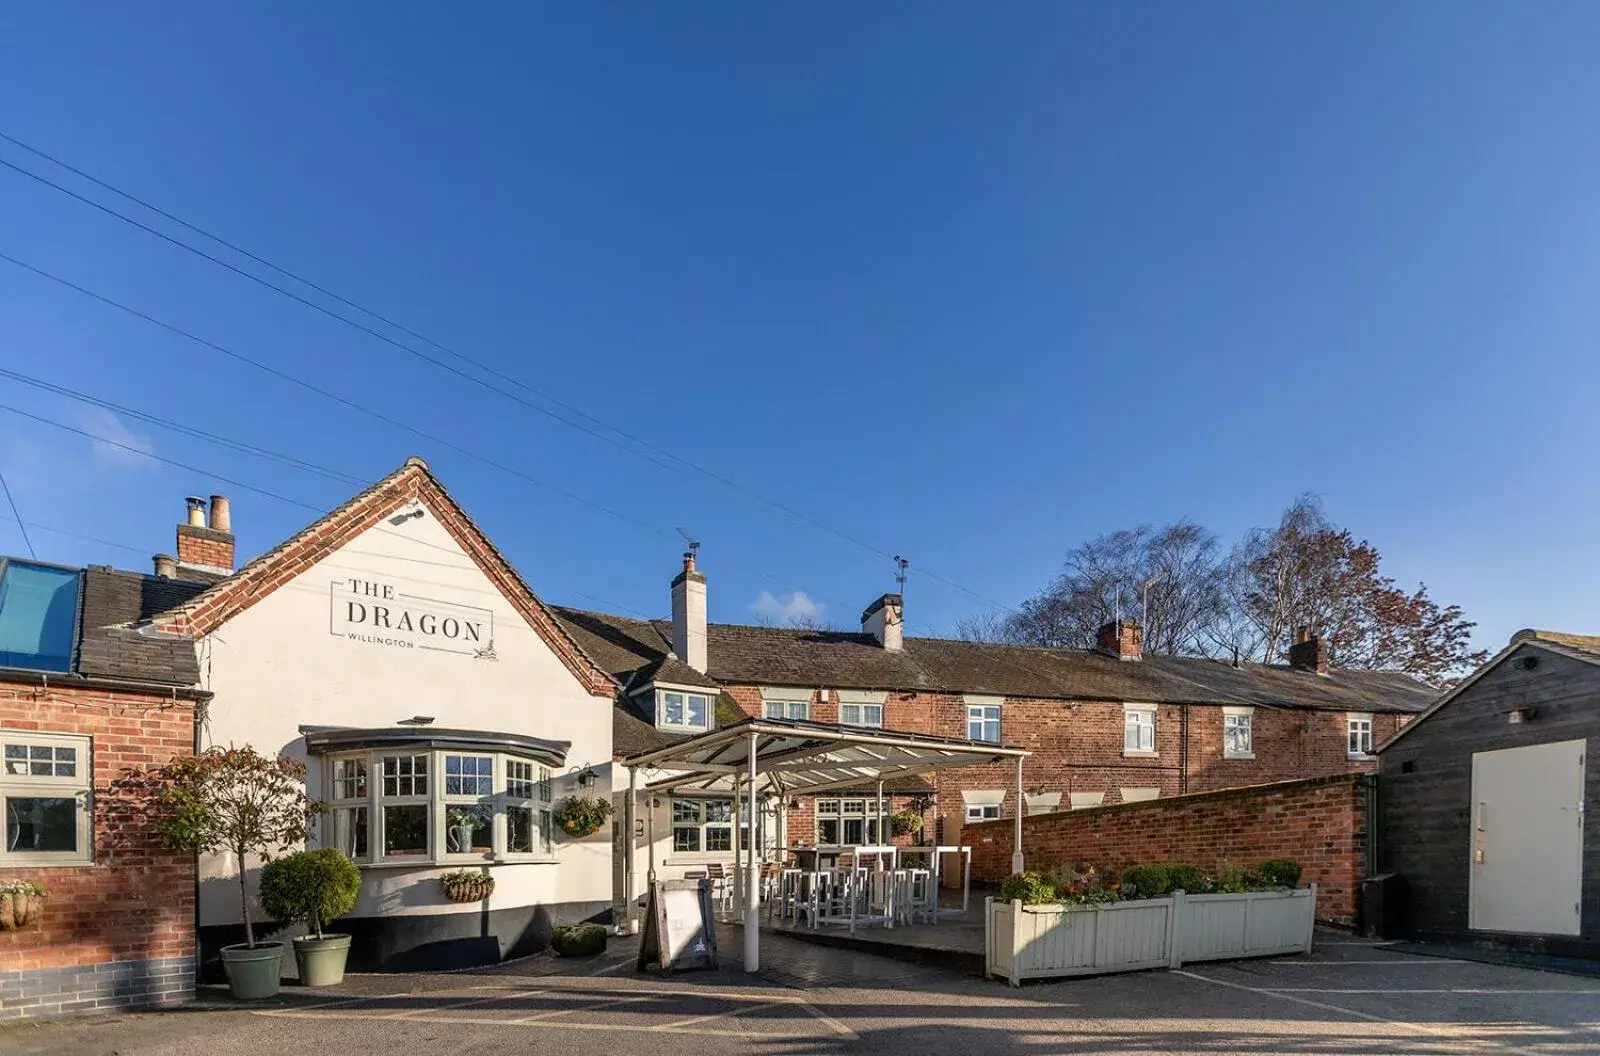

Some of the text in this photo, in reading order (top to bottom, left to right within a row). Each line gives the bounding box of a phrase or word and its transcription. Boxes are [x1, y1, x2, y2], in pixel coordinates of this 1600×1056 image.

[348, 579, 395, 600] THE
[347, 601, 483, 642] DRAGON
[348, 632, 414, 649] WILLINGTON
